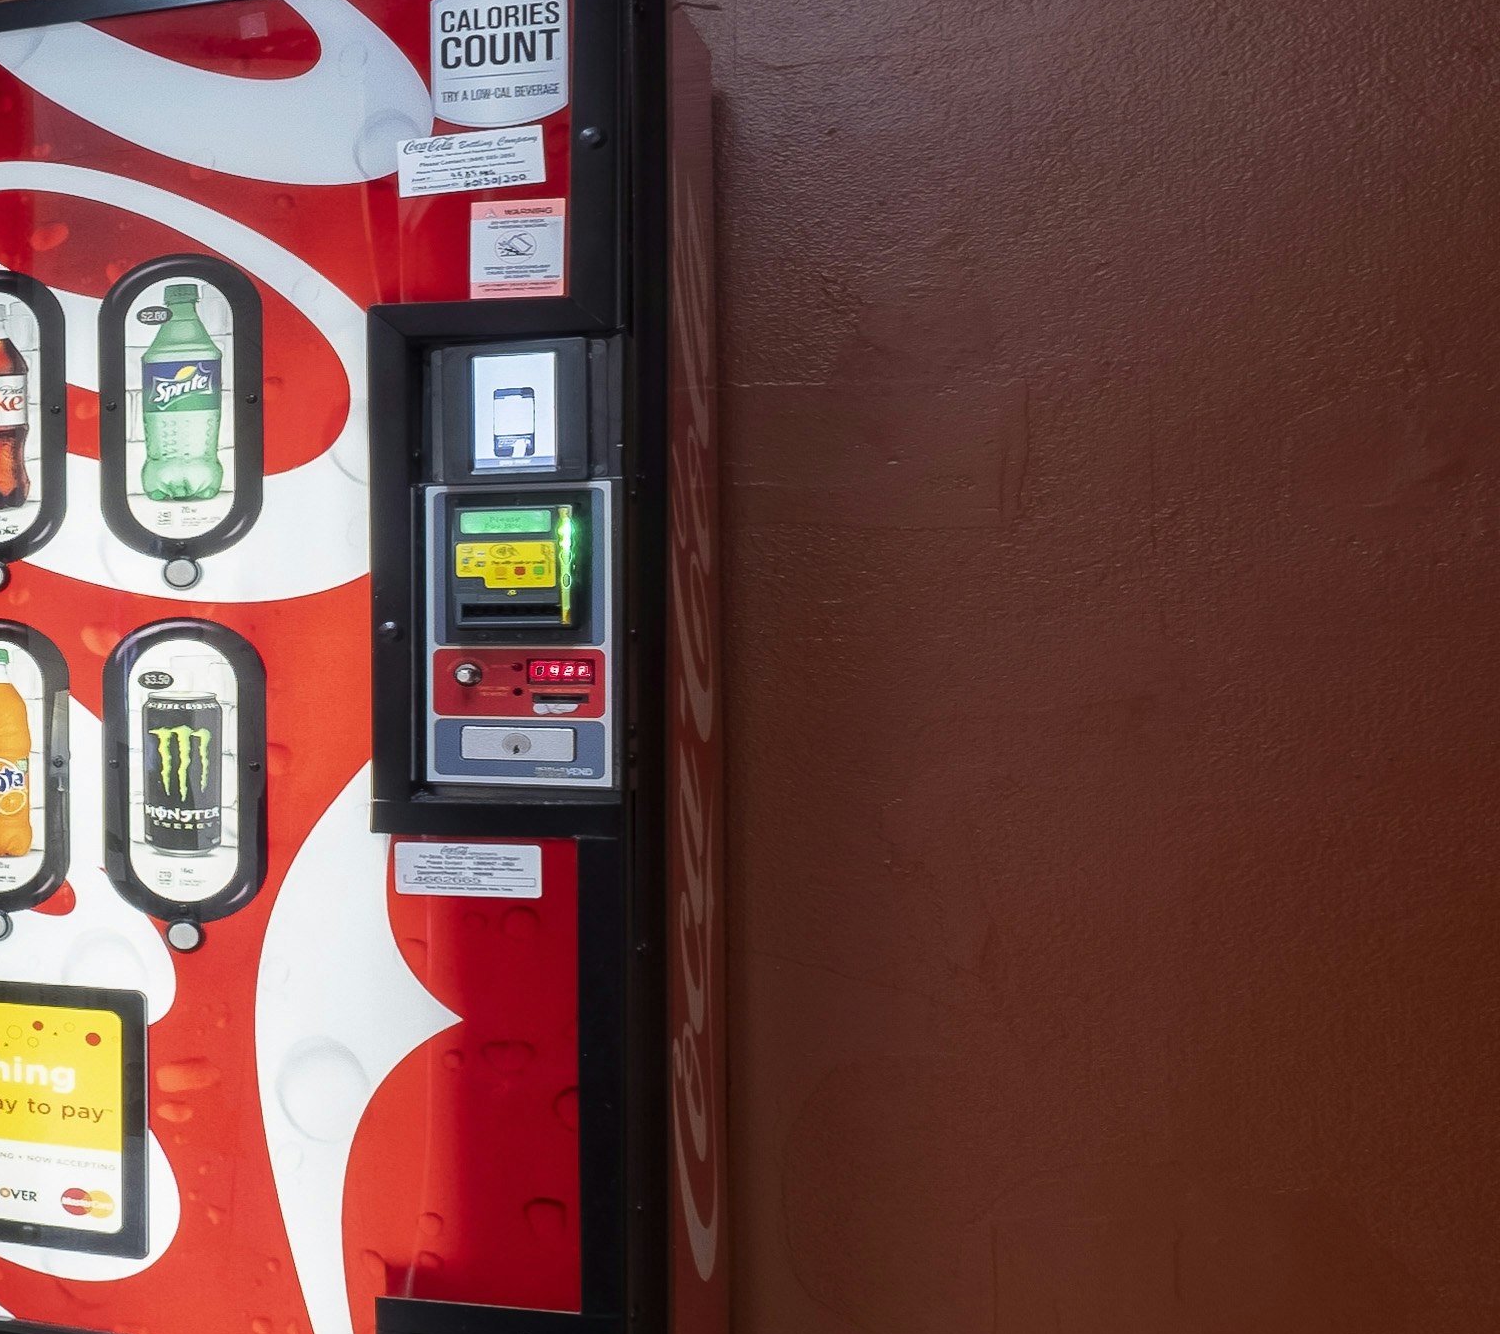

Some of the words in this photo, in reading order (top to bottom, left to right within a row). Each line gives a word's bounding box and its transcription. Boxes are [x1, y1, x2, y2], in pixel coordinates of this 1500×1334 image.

[440, 0, 560, 33] CALORIES
[441, 28, 561, 69] COUNT
[441, 91, 459, 103] TRY
[461, 90, 469, 101] A
[471, 86, 512, 101] LOW-CAL
[515, 83, 560, 98] BEVERAGE
[153, 373, 209, 404] Sprite
[145, 803, 221, 823] MONSTER
[27, 1098, 51, 1115] to
[61, 1102, 105, 1124] pay
[27, 1155, 53, 1164] NOW
[56, 1158, 116, 1172] ACCEPTING
